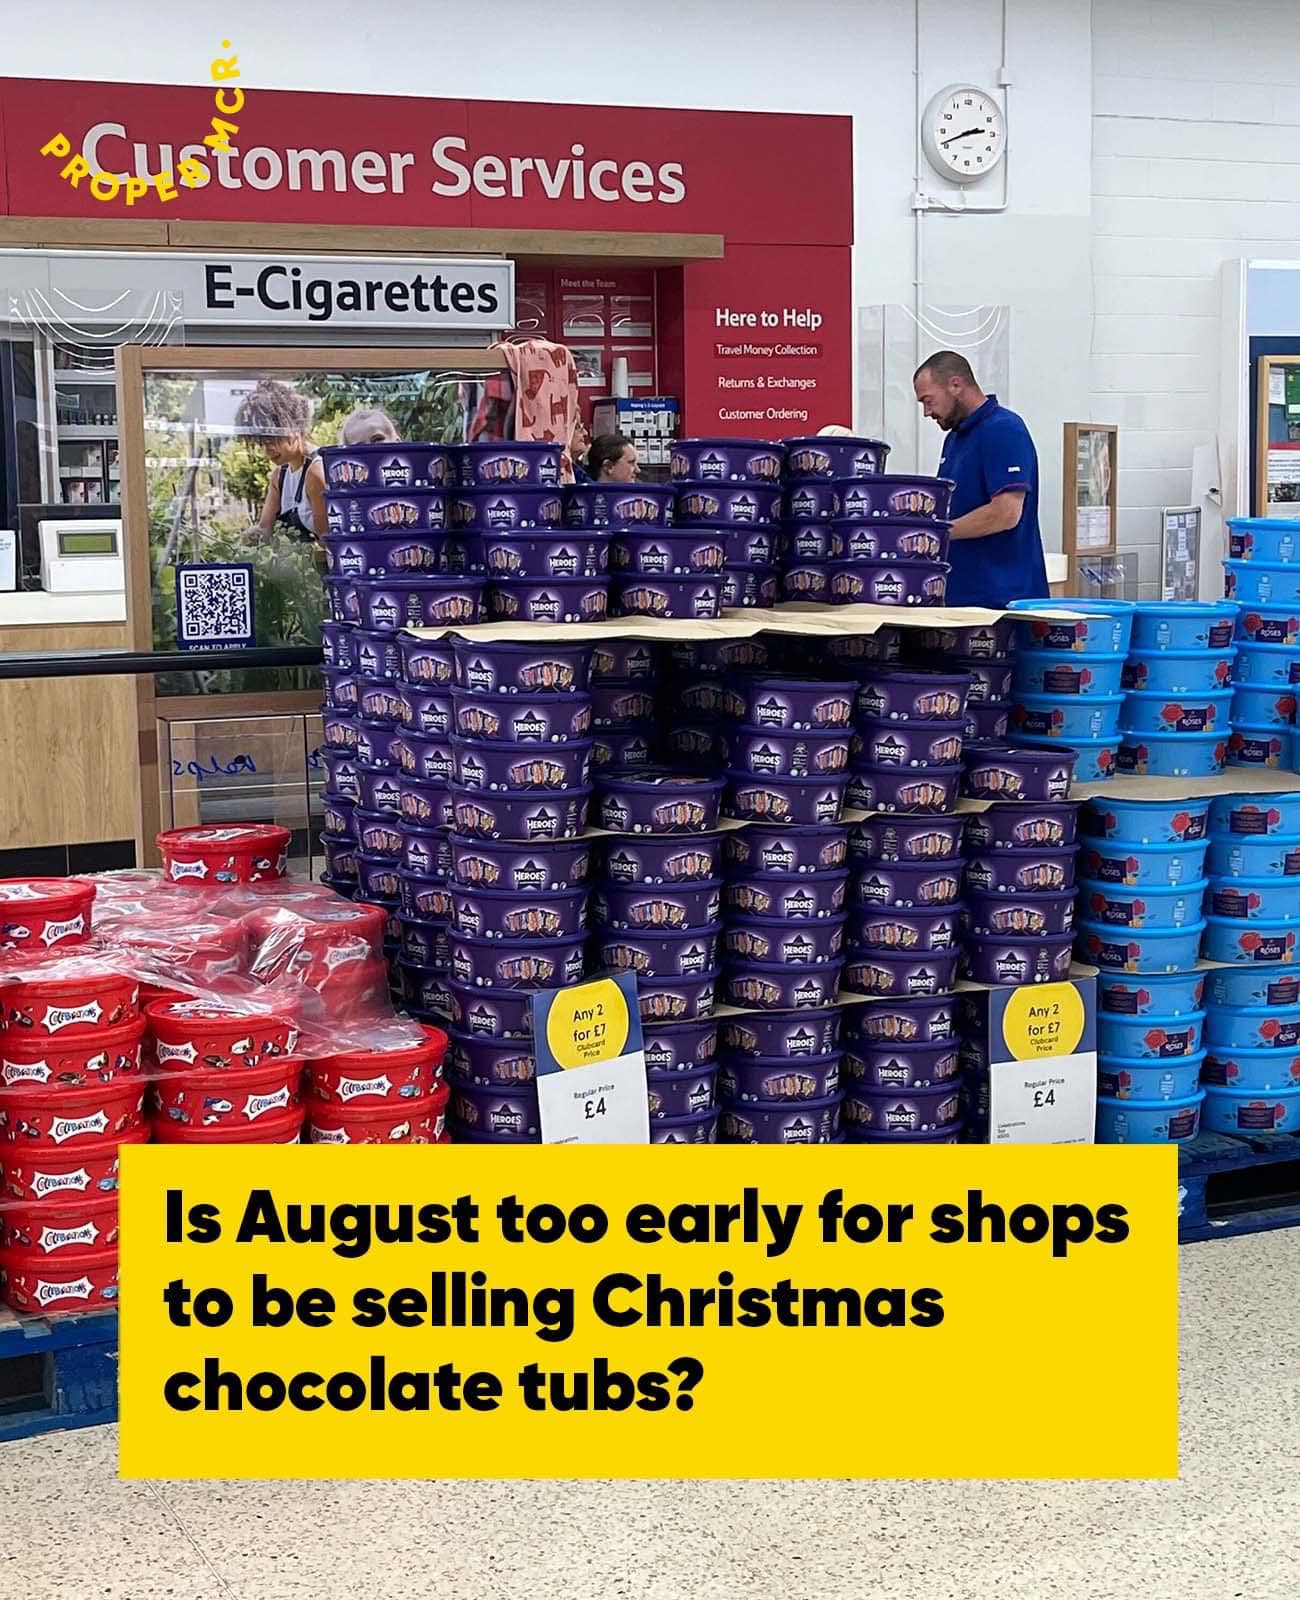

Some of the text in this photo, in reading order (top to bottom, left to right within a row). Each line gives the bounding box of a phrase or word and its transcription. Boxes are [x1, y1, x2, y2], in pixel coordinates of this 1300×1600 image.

[83, 122, 686, 203] Customer Services
[561, 279, 616, 288] Meet the Team
[204, 265, 498, 321] E-Cigarettes
[716, 308, 822, 331] Here to Help
[716, 344, 817, 357] Travel Money Collection
[718, 377, 816, 390] Returns & Exchanges
[719, 407, 808, 421] Customer Ordering
[700, 462, 725, 472] HEROES
[381, 469, 409, 479] HEROES
[731, 504, 756, 514] HEROES
[792, 500, 815, 509] HEROES
[845, 500, 867, 509] HEROES
[488, 509, 515, 519] HEROES
[797, 540, 821, 548] HEROES
[850, 541, 874, 550] HEROES
[550, 558, 577, 567] HEROES
[640, 555, 667, 564] HEROES
[875, 583, 902, 593] HEROES
[530, 602, 559, 611] HEROES
[372, 608, 396, 618] HEROES
[969, 640, 994, 649] HEROES
[468, 672, 492, 681] HEROES
[757, 708, 786, 718] HEROES
[421, 715, 447, 723] HEROES
[514, 722, 545, 731] HEROES
[875, 747, 905, 756] HEROES
[751, 755, 781, 764] HEROES
[425, 761, 452, 770] HEROES
[375, 791, 400, 800] HEROES
[527, 820, 556, 829] HEROES
[763, 853, 793, 862] HEROES
[610, 863, 638, 872] HEROES
[514, 872, 545, 881] HEROES
[861, 885, 888, 895] HEROES
[784, 901, 814, 909] HEROES
[783, 946, 813, 954] HEROES
[680, 956, 704, 964] HEROES
[996, 962, 1025, 970] HEROES
[908, 977, 934, 986] HEROES
[423, 993, 450, 1001] HEROES
[794, 990, 820, 999] HEROES
[573, 1004, 603, 1022] Any 2
[1029, 1004, 1059, 1018] Any 2
[470, 1017, 496, 1026] HEROES
[573, 1023, 606, 1042] for £7
[1028, 1022, 1060, 1036] for £7
[787, 1039, 814, 1047] HEROES
[1030, 1036, 1058, 1045] Clubcard
[577, 1040, 606, 1051] Clubcard
[584, 1050, 600, 1058] Price
[645, 1053, 671, 1062] EROES
[879, 1069, 907, 1078] HEROES
[1024, 1080, 1047, 1088] Regular
[574, 1084, 615, 1099] Regular Price
[1033, 1089, 1055, 1108] £4
[585, 1097, 607, 1119] £4
[490, 1115, 521, 1124] HEROES
[886, 1114, 915, 1122] HEROES
[784, 1129, 811, 1138] HEROES
